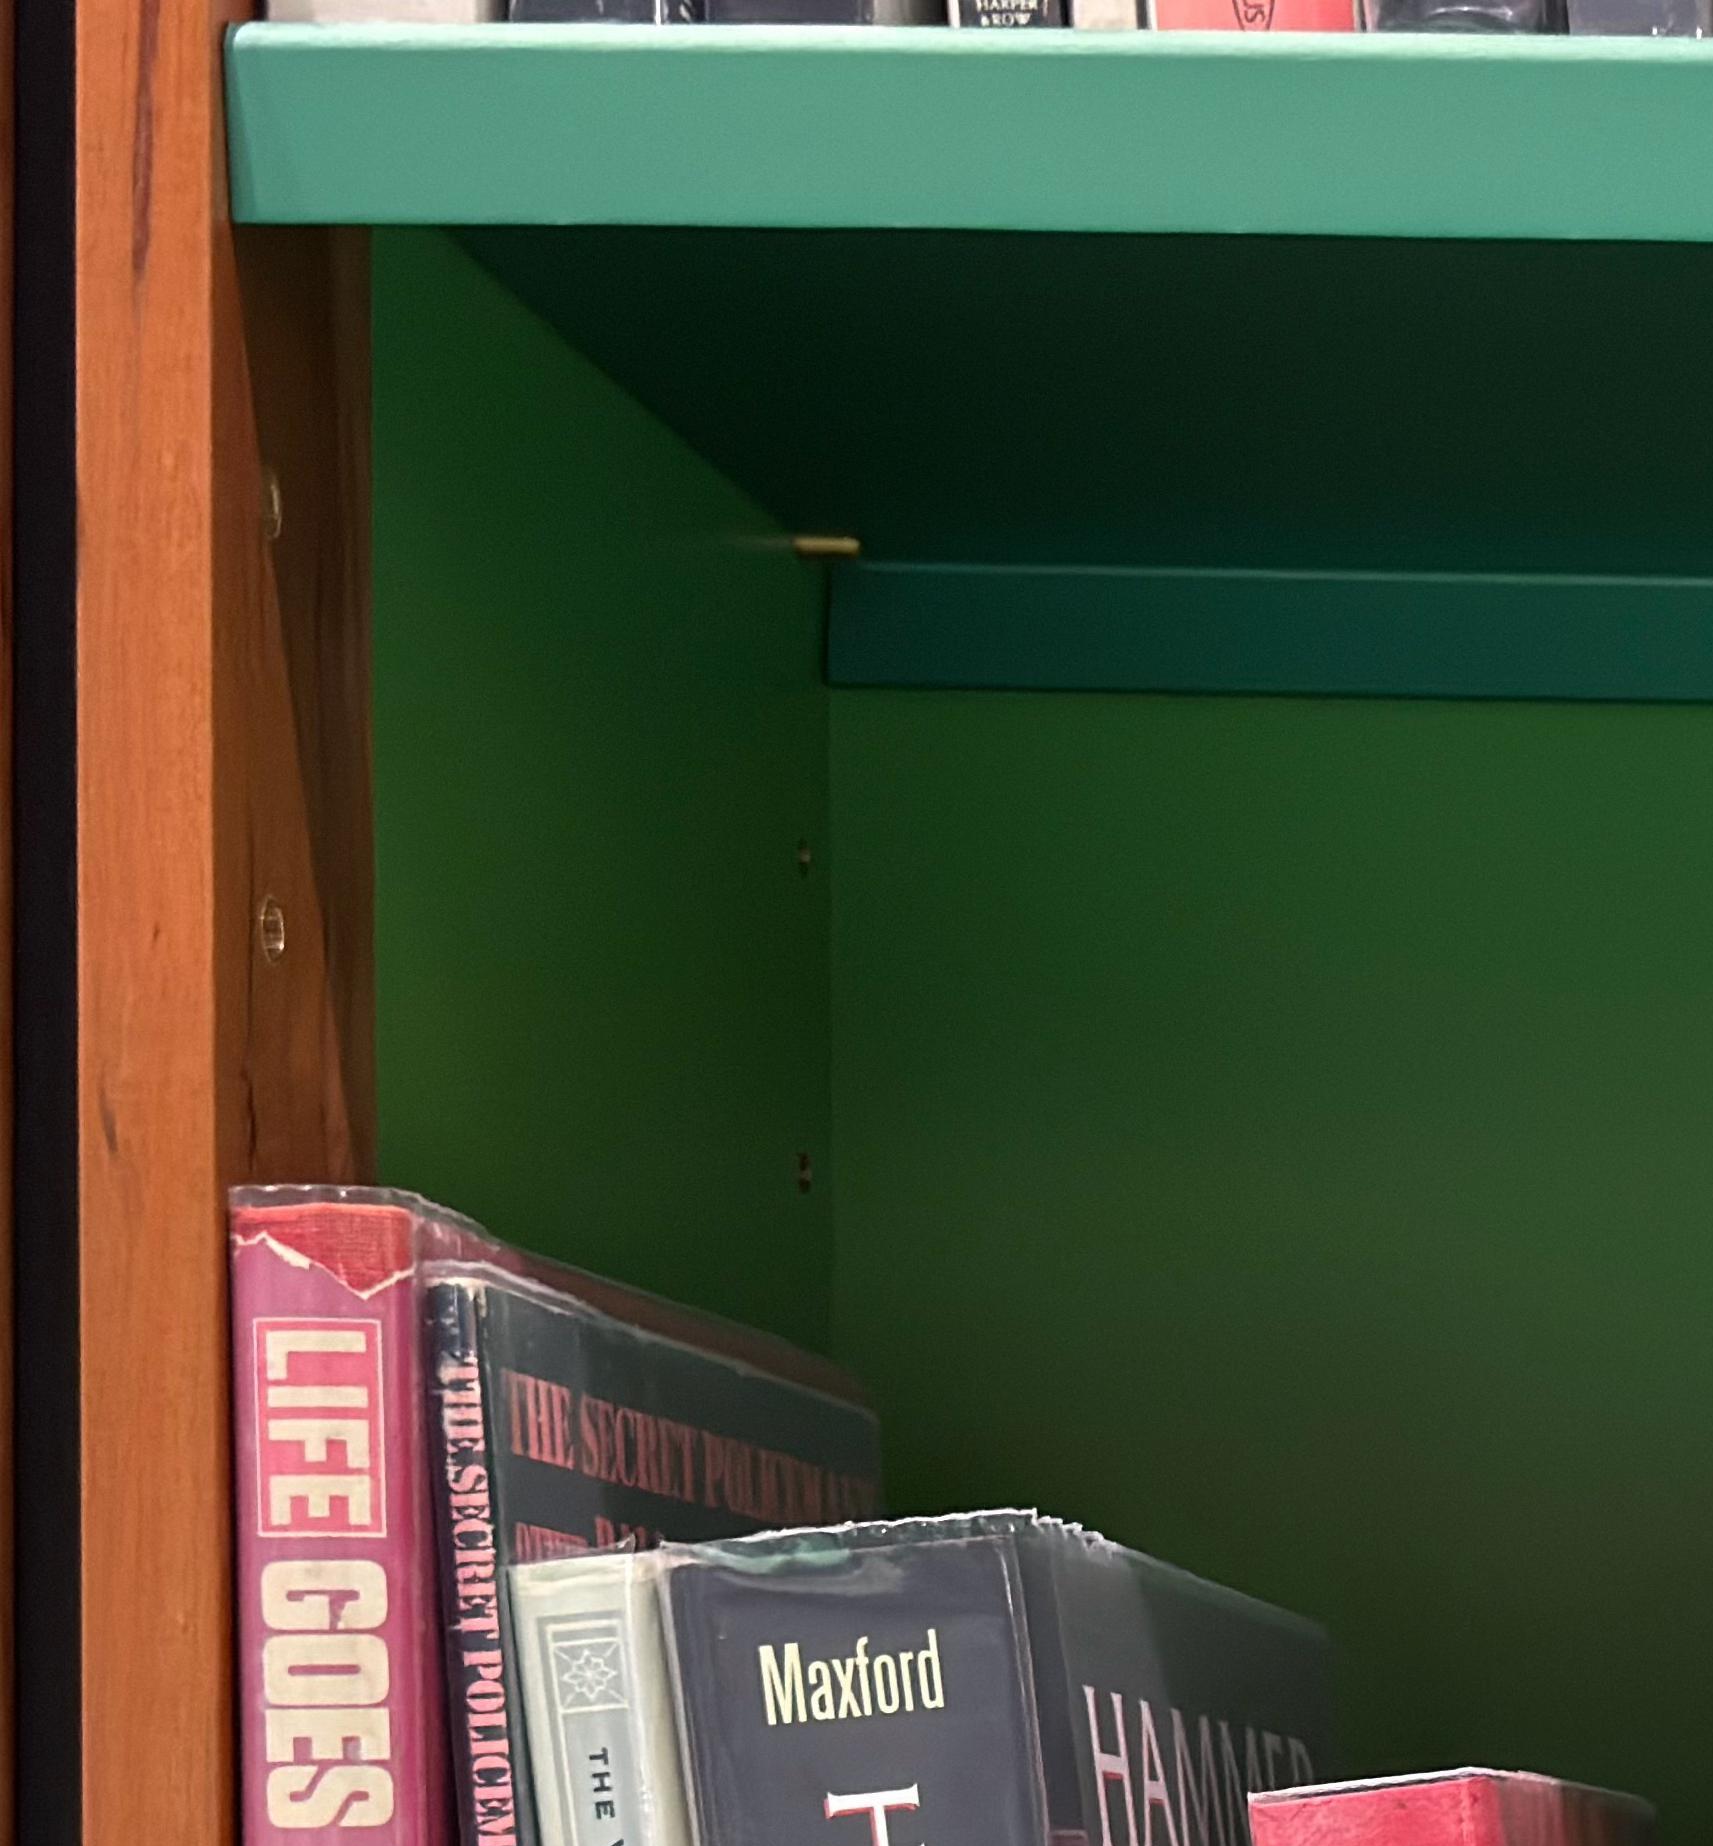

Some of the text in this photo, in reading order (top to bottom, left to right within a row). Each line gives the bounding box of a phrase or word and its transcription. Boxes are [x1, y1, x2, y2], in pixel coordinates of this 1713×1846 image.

[264, 1330, 372, 1527] LIFE
[449, 1464, 498, 1639] SECRET
[260, 1560, 394, 1828] GOES
[758, 1627, 945, 1726] Maxford
[587, 1747, 616, 1820] THE
